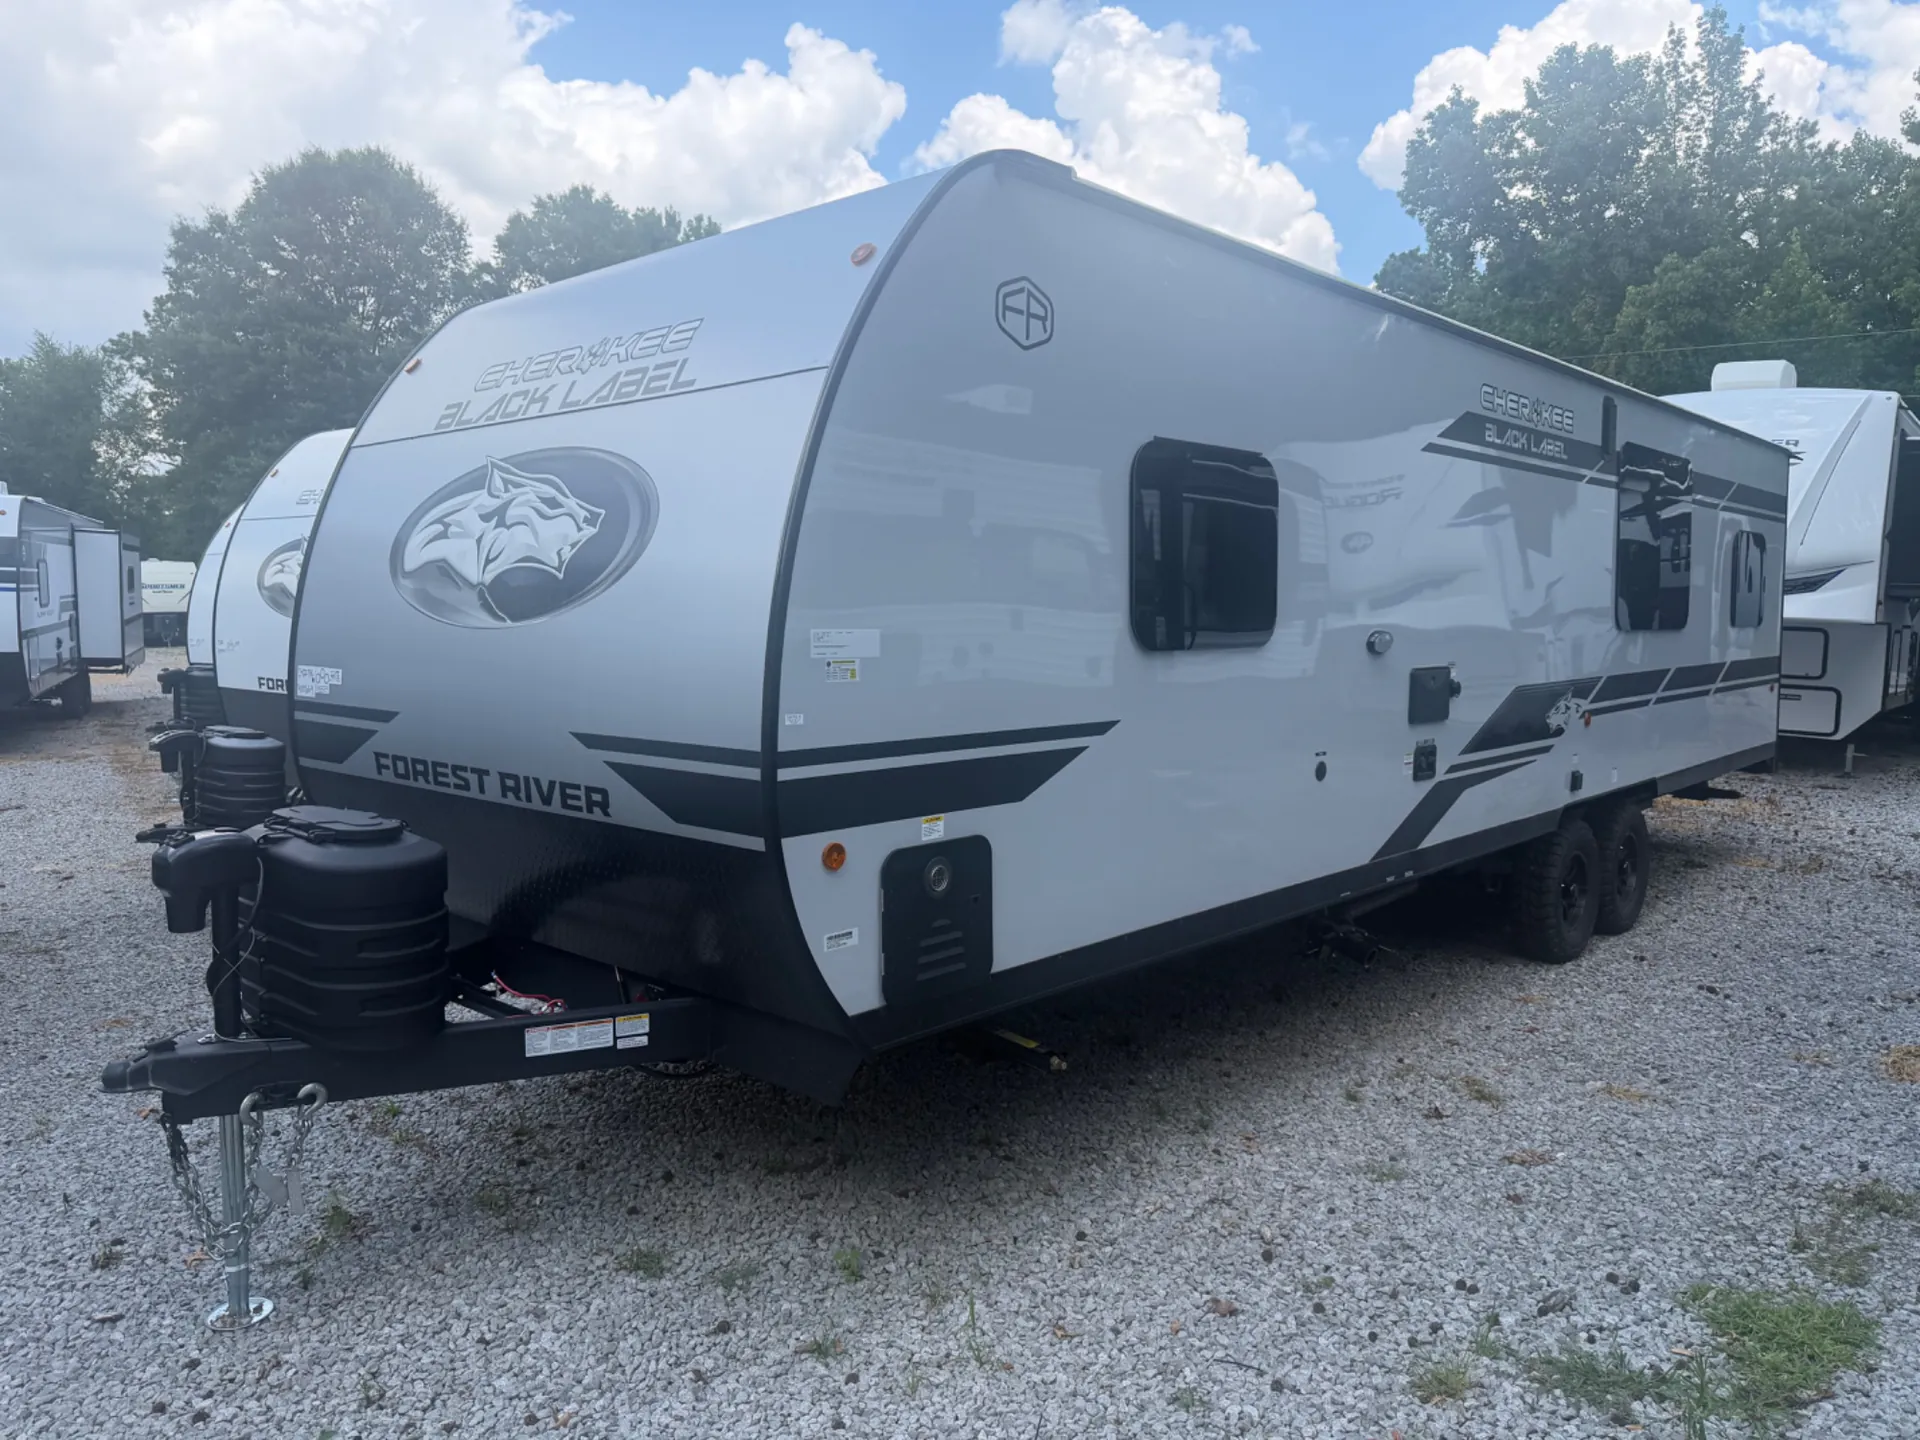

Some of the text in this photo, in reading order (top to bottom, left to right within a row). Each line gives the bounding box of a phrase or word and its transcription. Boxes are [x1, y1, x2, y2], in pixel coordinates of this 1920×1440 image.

[474, 317, 705, 392] CHEROKEE
[434, 357, 697, 431] BLACK LABEL
[1480, 382, 1574, 434] CHEROKEE
[1484, 422, 1568, 460] BLACK LABEL
[257, 676, 289, 692] FOR
[373, 751, 613, 818] FOREST RIVER
